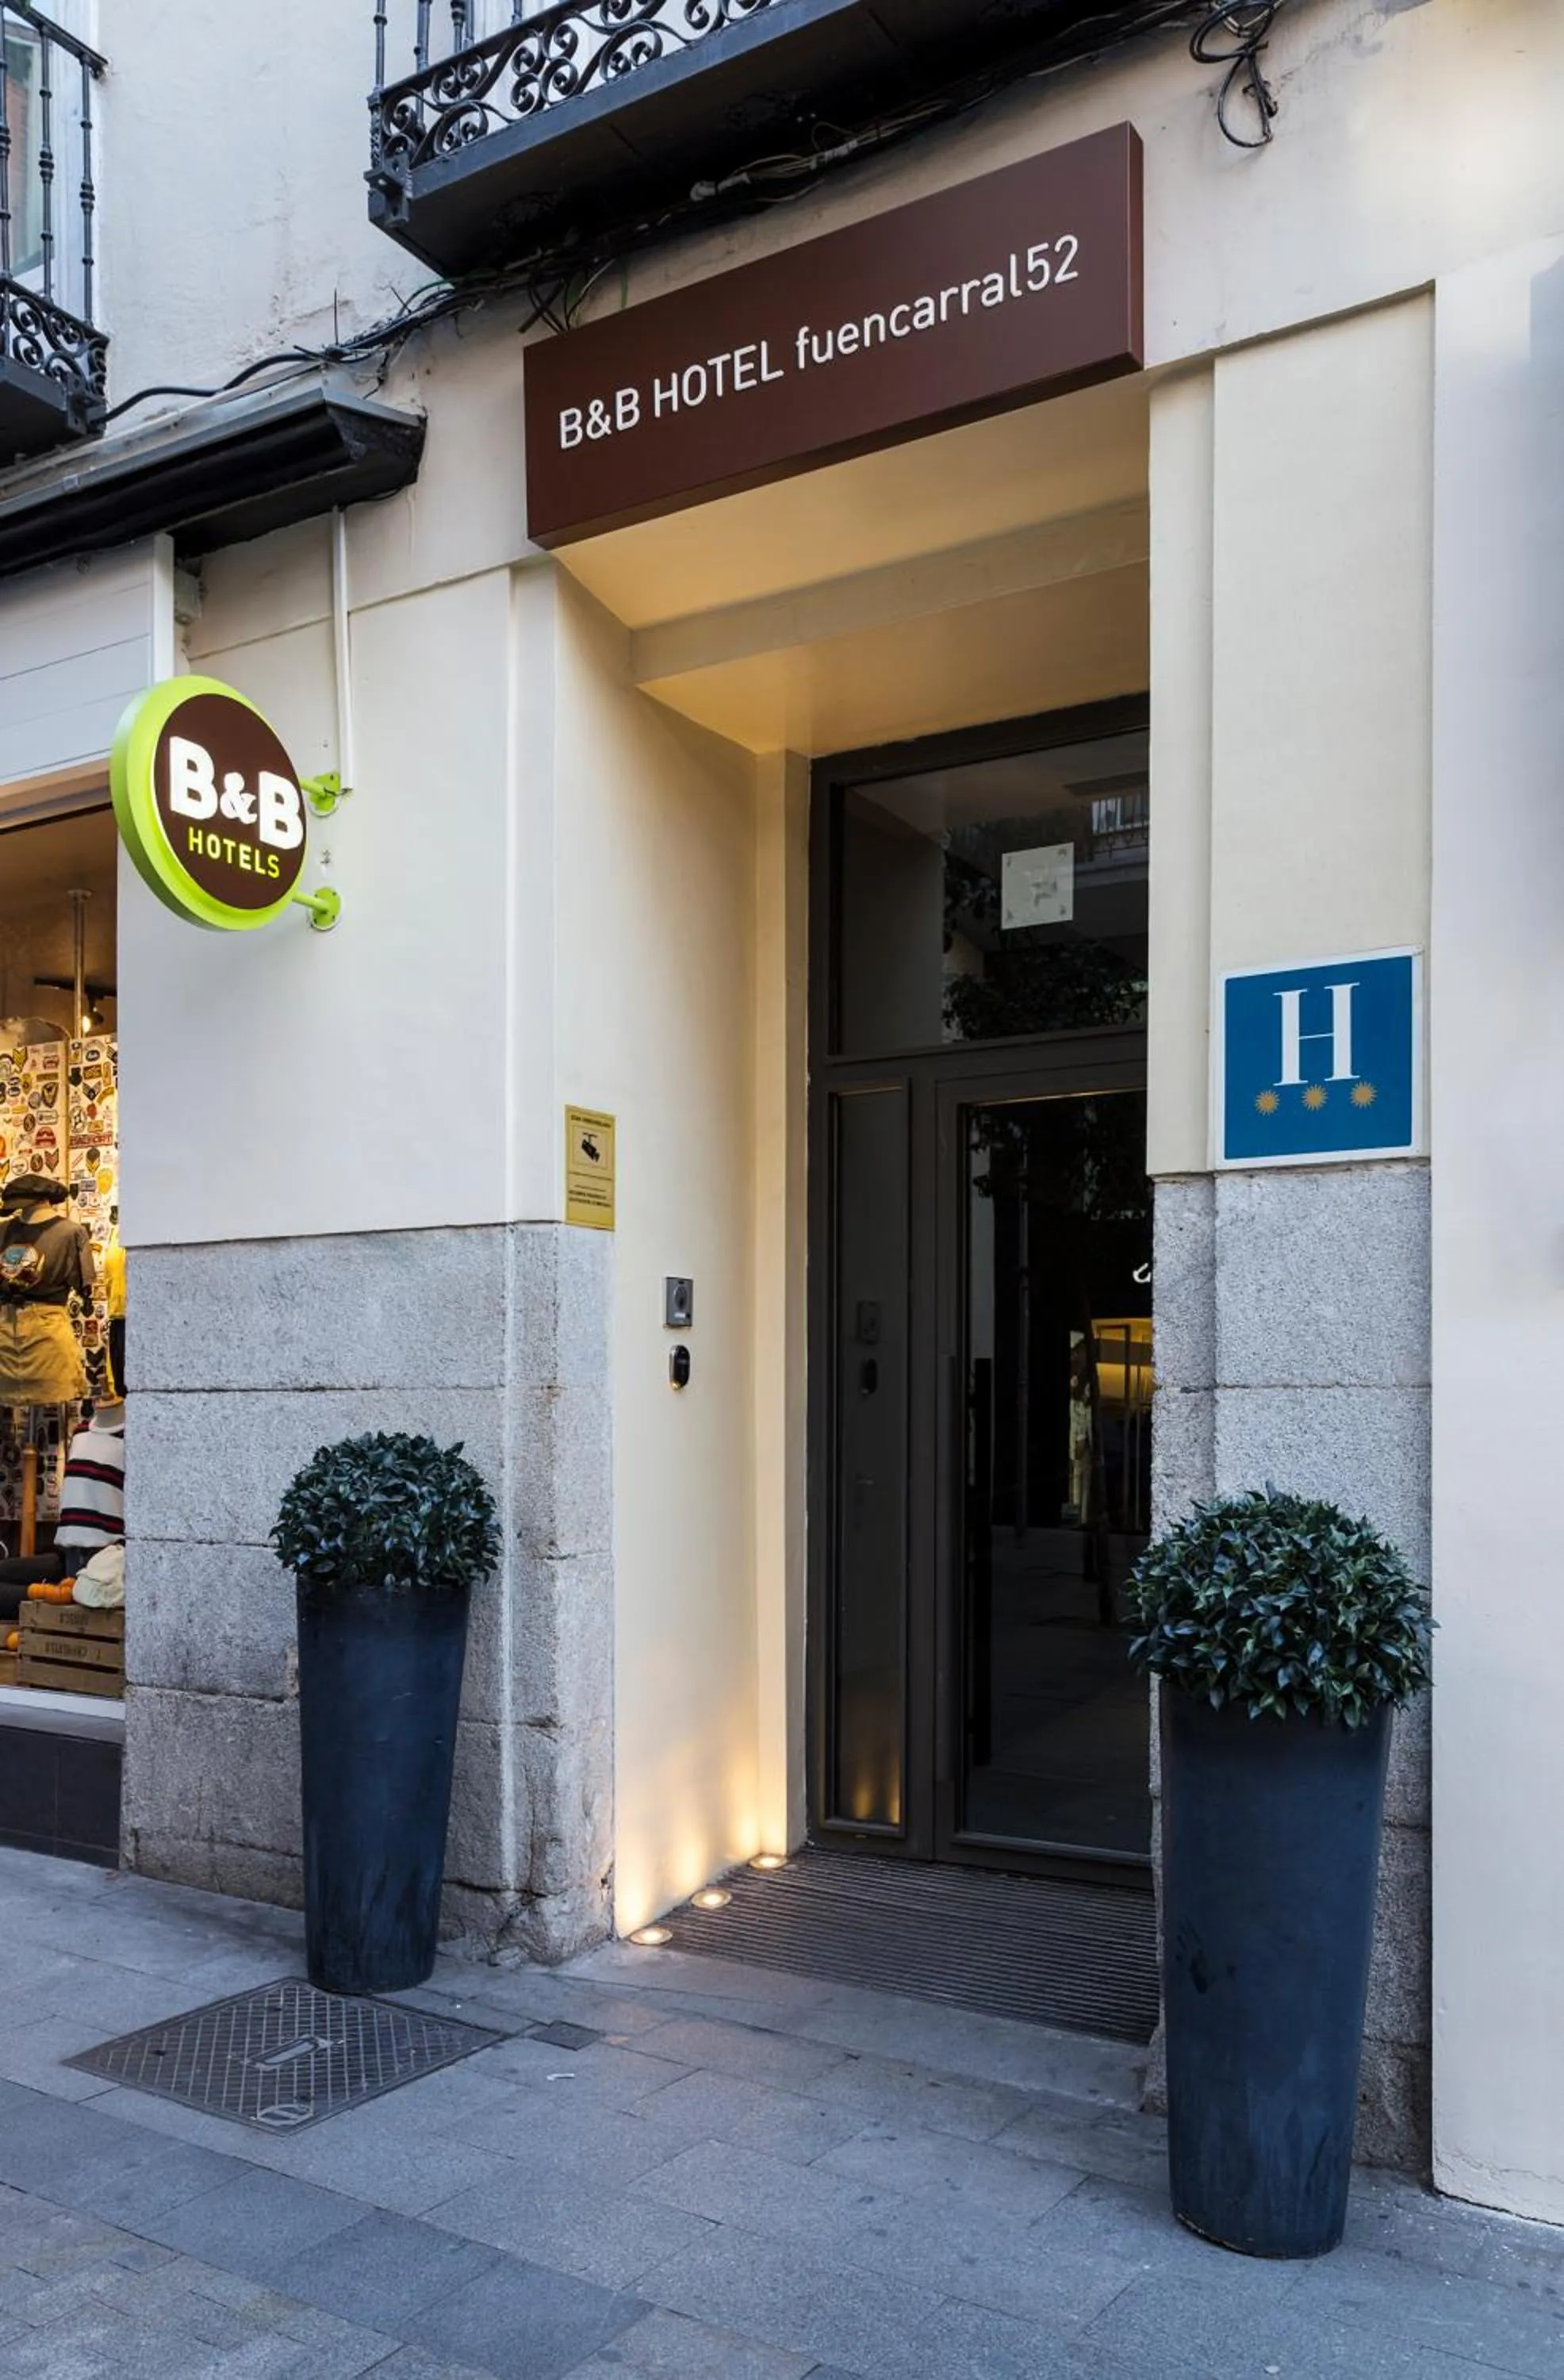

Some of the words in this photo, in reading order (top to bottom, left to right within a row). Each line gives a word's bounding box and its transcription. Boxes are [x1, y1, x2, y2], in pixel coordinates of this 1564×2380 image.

[559, 386, 641, 450] B&B
[654, 340, 785, 418] HOTEL
[169, 735, 305, 850] B&B
[188, 827, 281, 879] HOTELS
[1272, 982, 1361, 1087] H
